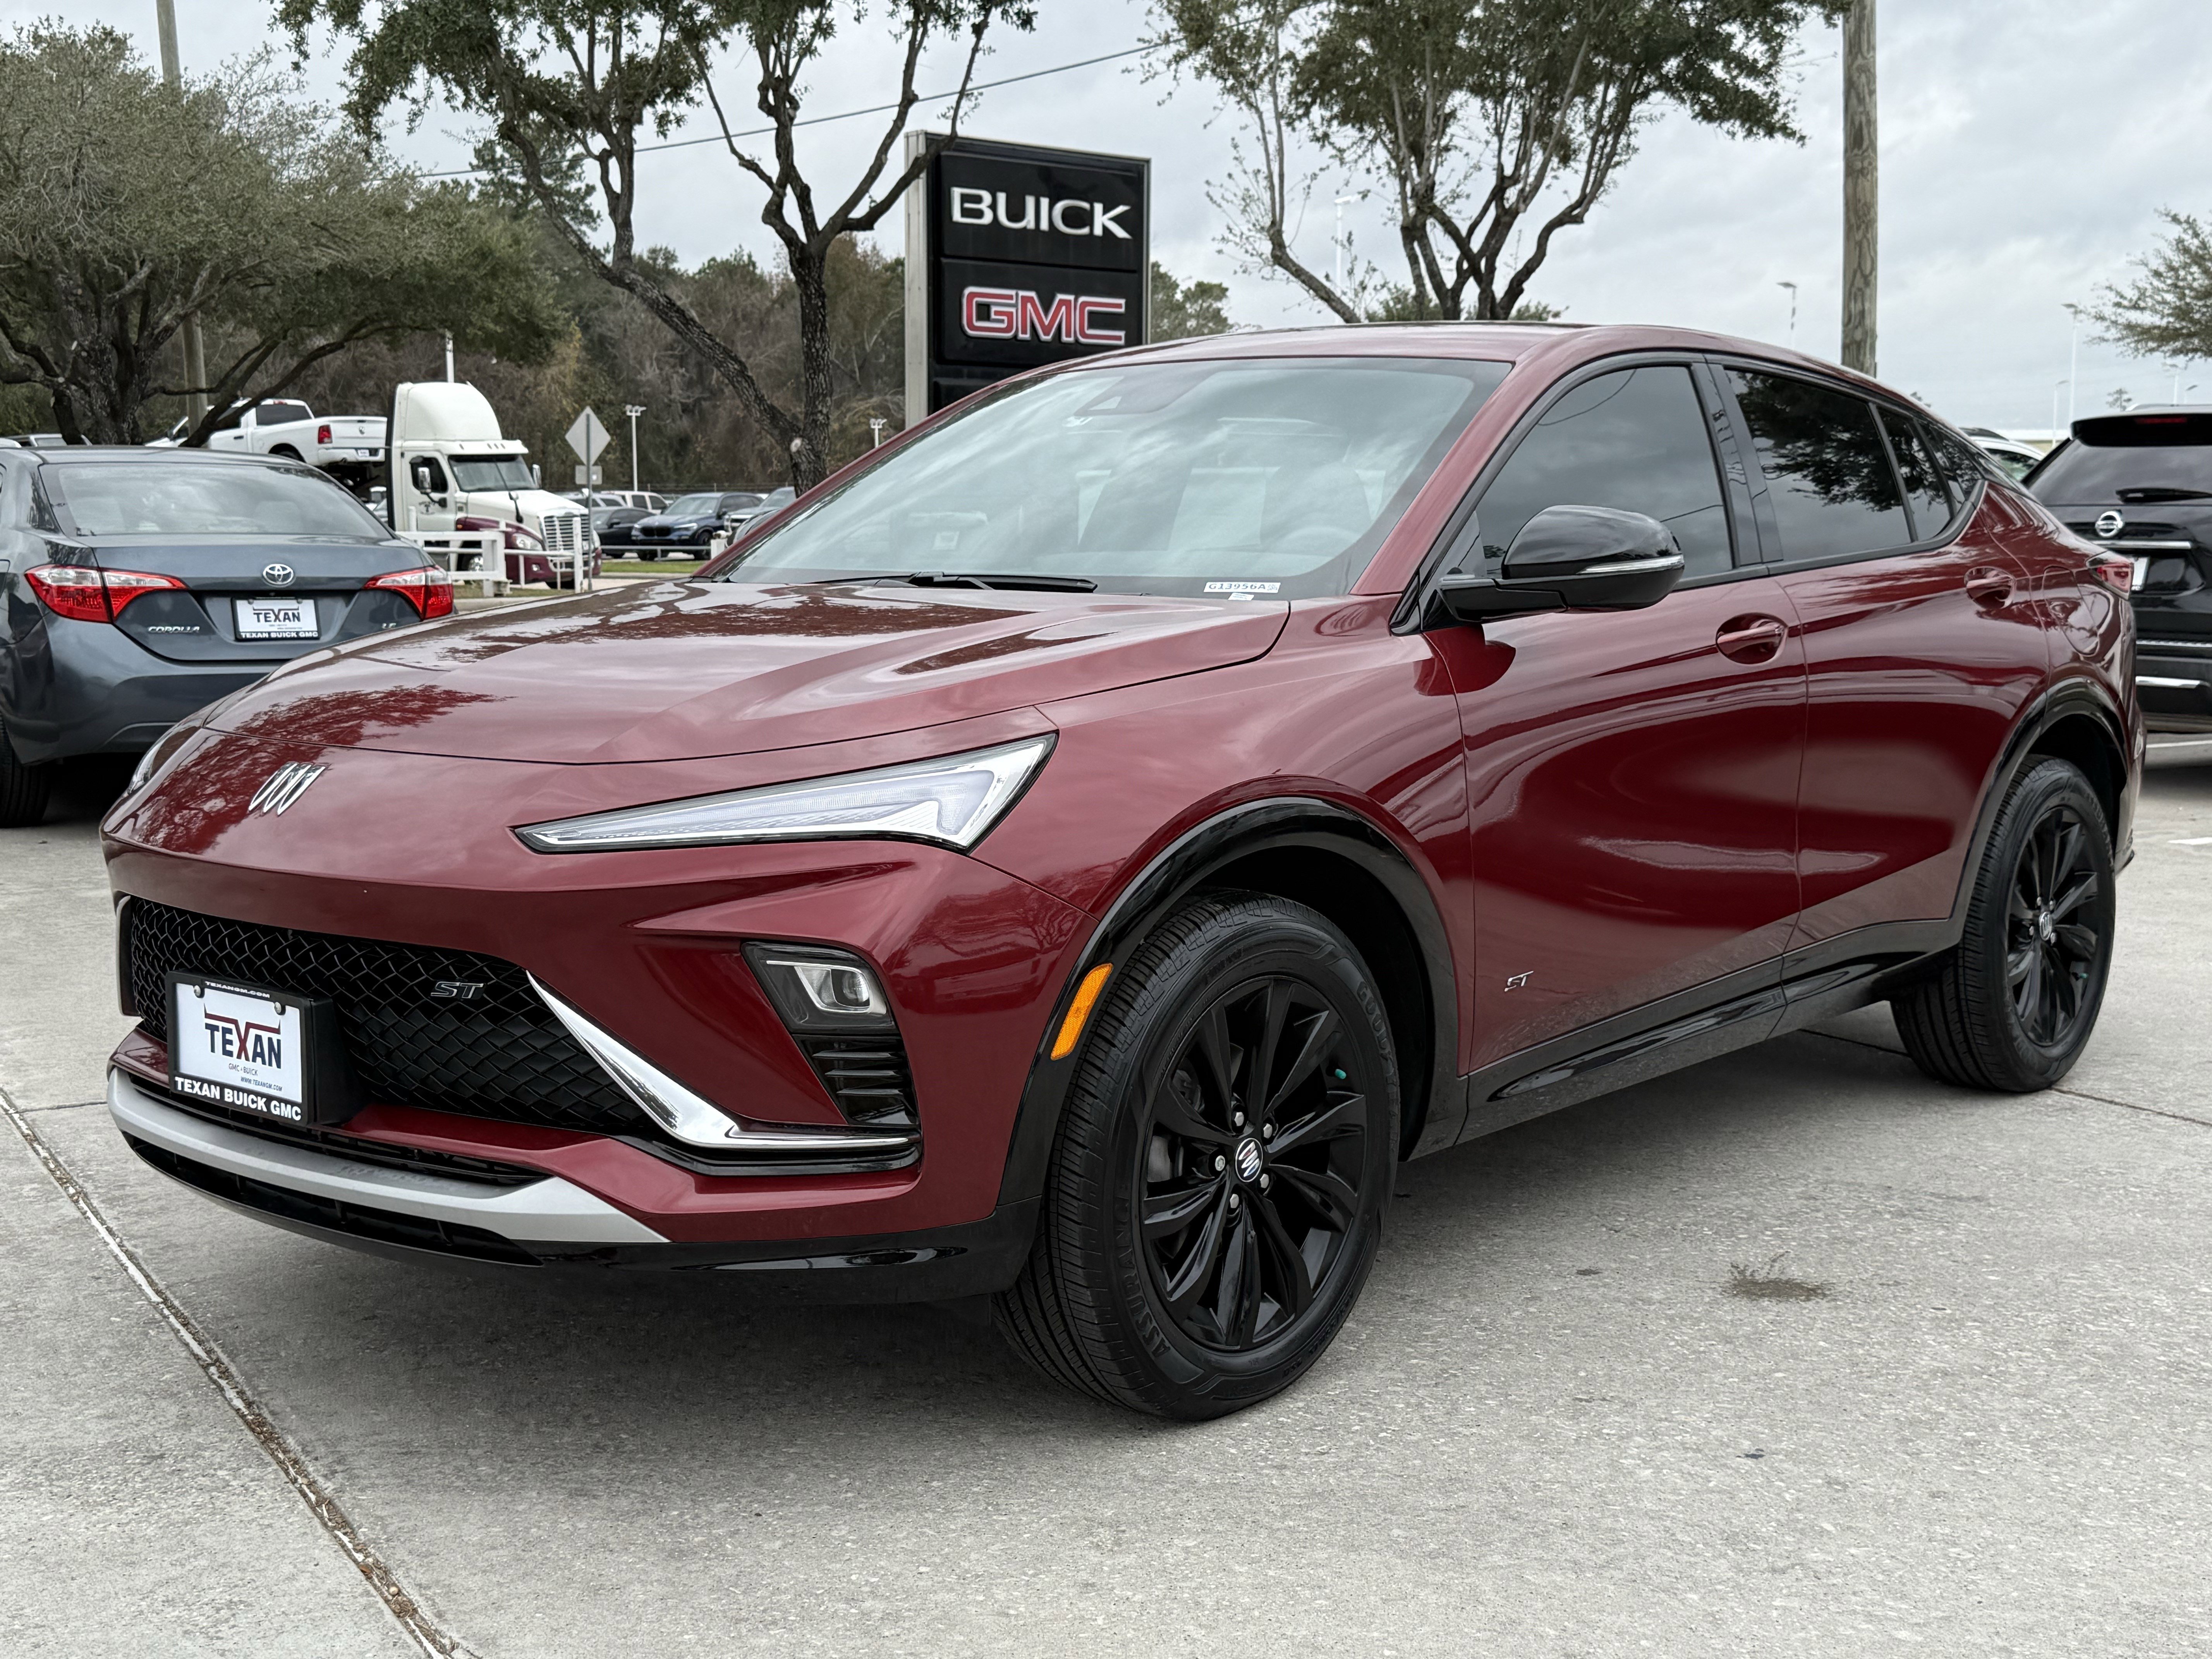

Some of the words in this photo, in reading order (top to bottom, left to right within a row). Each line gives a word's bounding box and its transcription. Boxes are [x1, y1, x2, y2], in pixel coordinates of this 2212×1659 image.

[950, 187, 1132, 239] BUICK
[962, 286, 1126, 345] GMC
[253, 608, 301, 623] TEXAN
[205, 981, 270, 998] TEXANGM.COM
[430, 981, 484, 998] ST
[1504, 970, 1534, 992] ST
[205, 1019, 281, 1069] TEXAN
[228, 1063, 239, 1072] GMC
[243, 1066, 258, 1076] BUICK
[175, 1076, 220, 1099] TEXAN
[224, 1088, 267, 1112] BUICK
[271, 1100, 301, 1121] GMC
